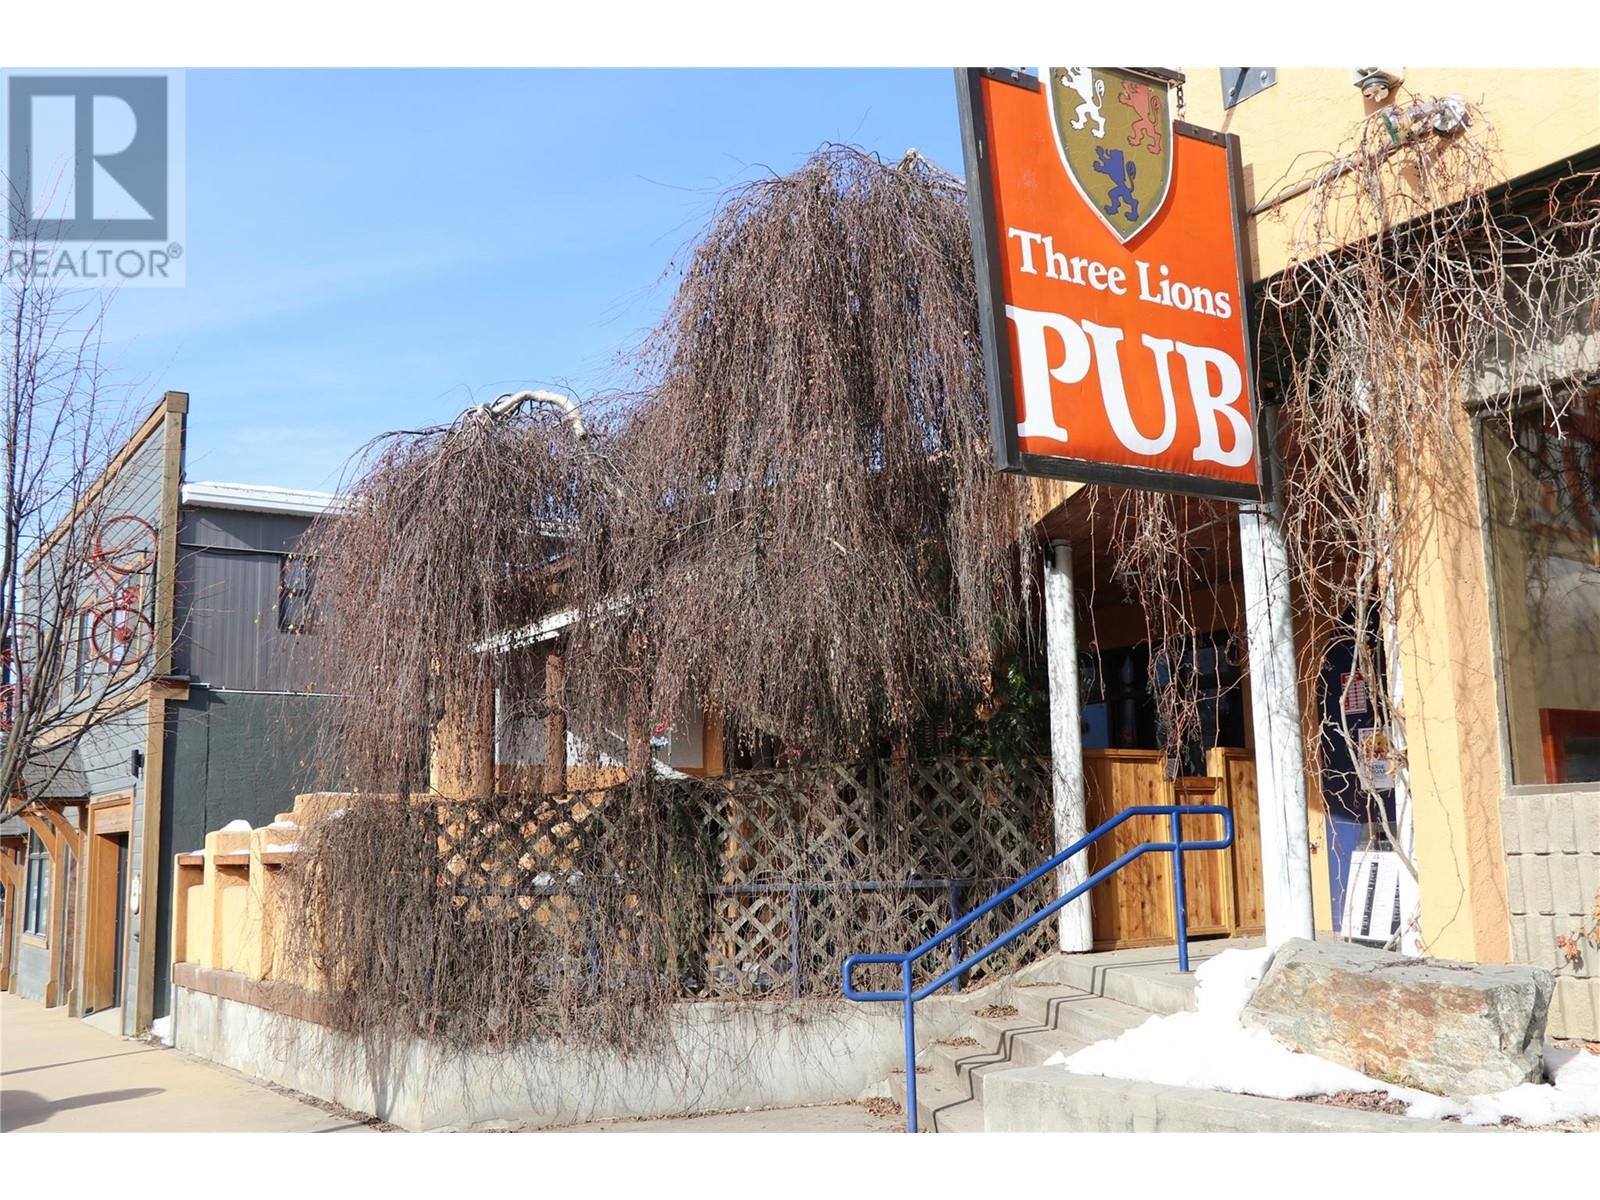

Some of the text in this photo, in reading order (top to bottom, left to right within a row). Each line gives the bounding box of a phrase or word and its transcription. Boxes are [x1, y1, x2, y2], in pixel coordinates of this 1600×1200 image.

[1008, 227, 1232, 318] Three Lions
[1005, 304, 1253, 467] PUB
